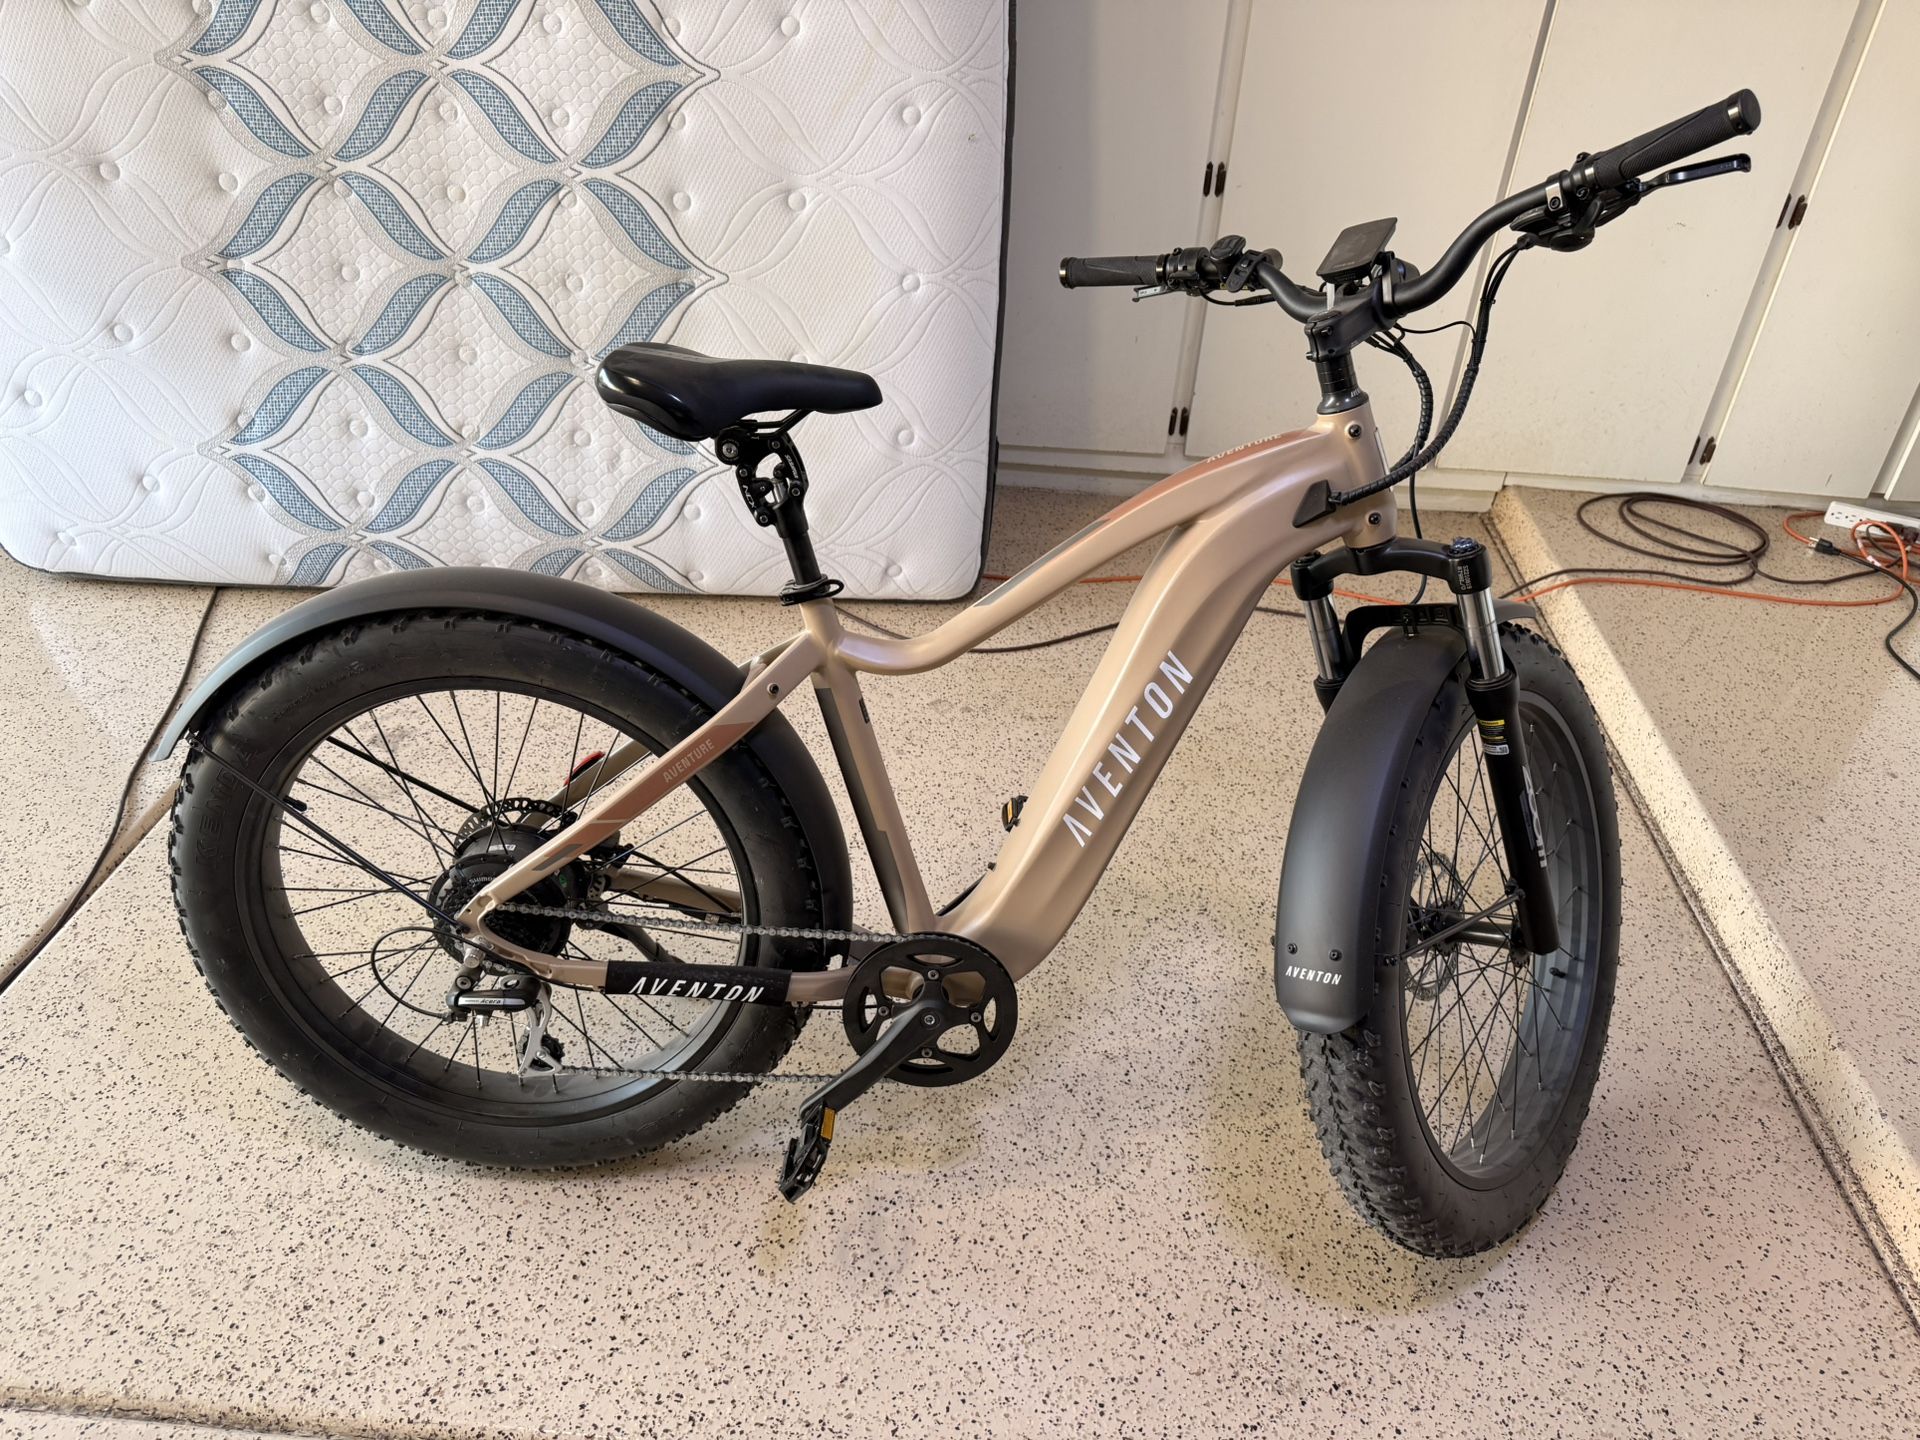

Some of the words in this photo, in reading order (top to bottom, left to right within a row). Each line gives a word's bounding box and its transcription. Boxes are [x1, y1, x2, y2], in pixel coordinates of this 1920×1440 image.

[663, 738, 716, 783] AVENTURE
[1063, 650, 1193, 848] AVENTON
[628, 976, 765, 1003] AVENTON
[1285, 965, 1342, 986] AVENTON
